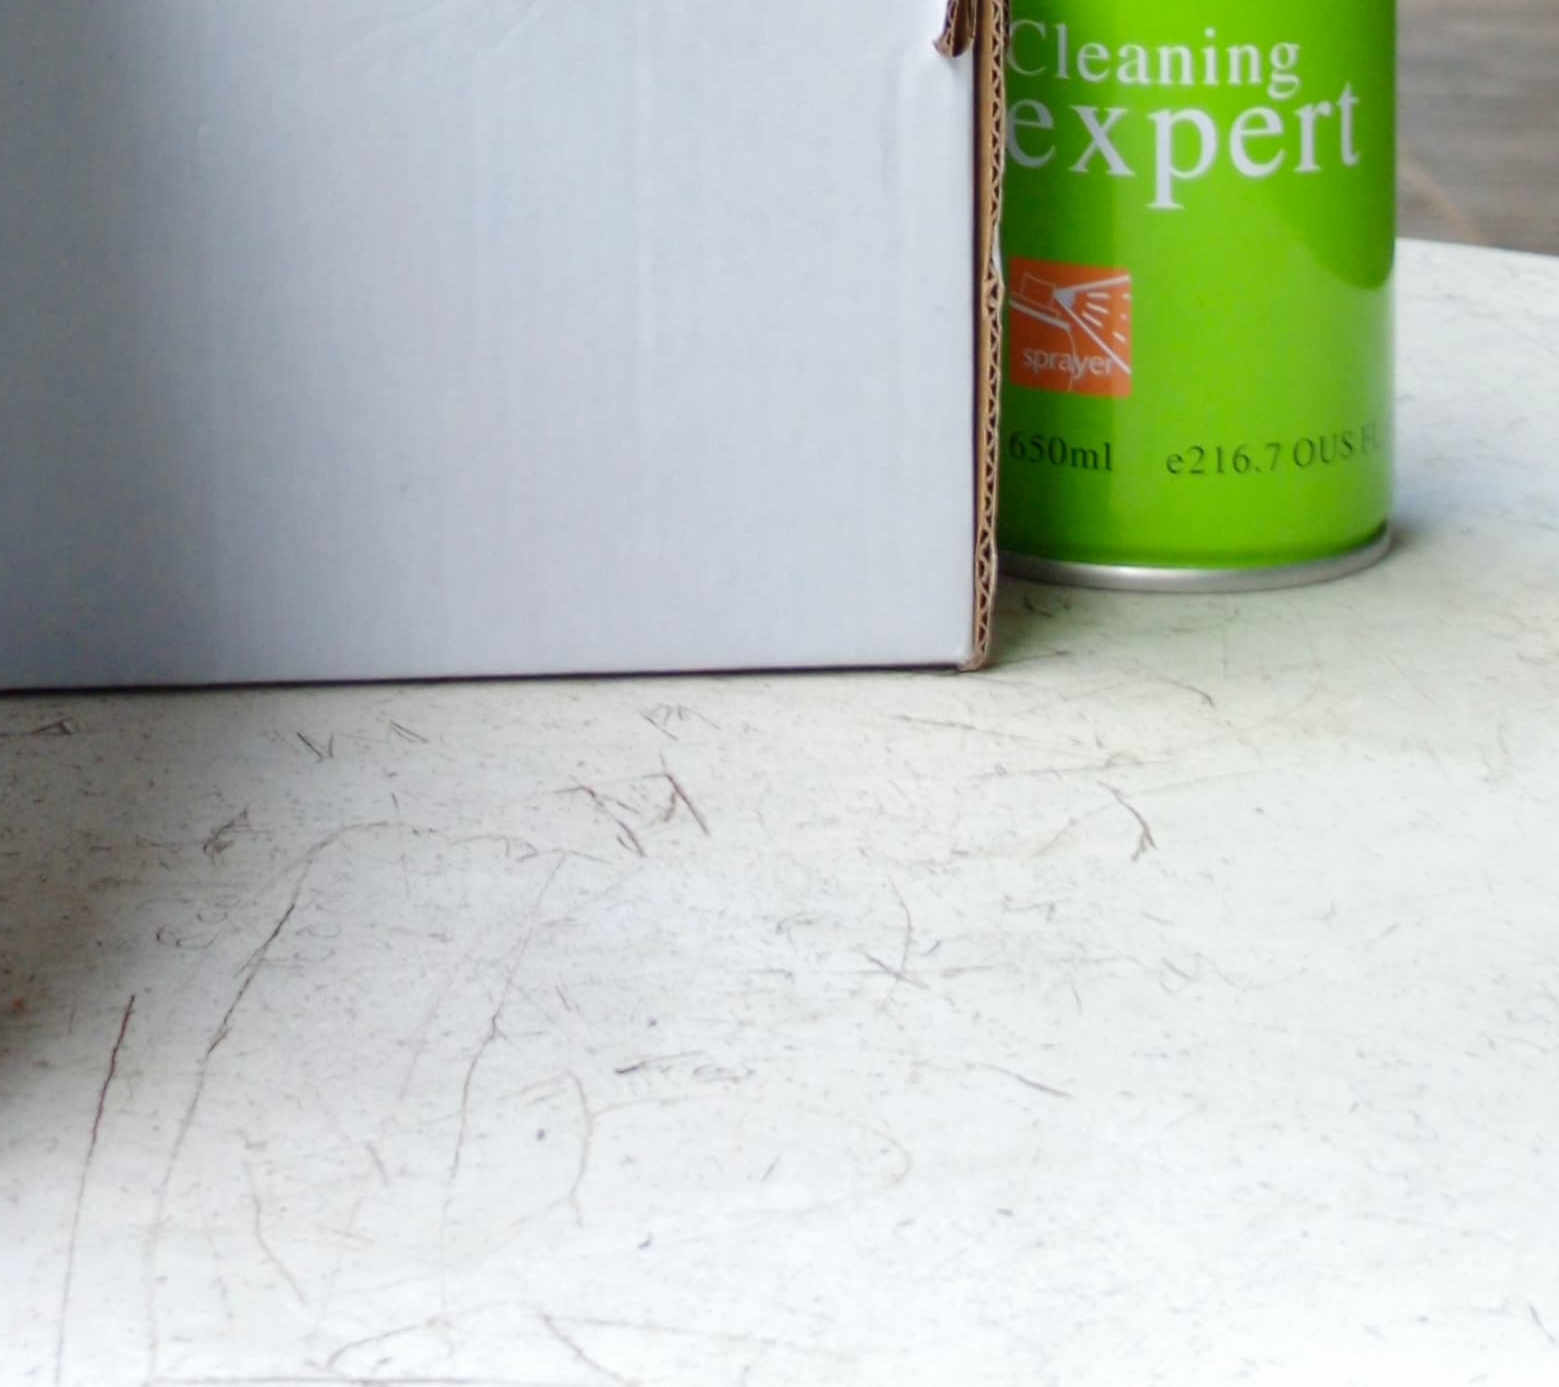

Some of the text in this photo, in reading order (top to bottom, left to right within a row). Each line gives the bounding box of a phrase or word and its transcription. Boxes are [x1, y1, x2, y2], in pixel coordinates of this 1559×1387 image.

[1007, 19, 1301, 101] Cleaning
[1005, 81, 1361, 211] expert
[1023, 346, 1115, 380] sprayer
[1008, 432, 1113, 472] 650ml
